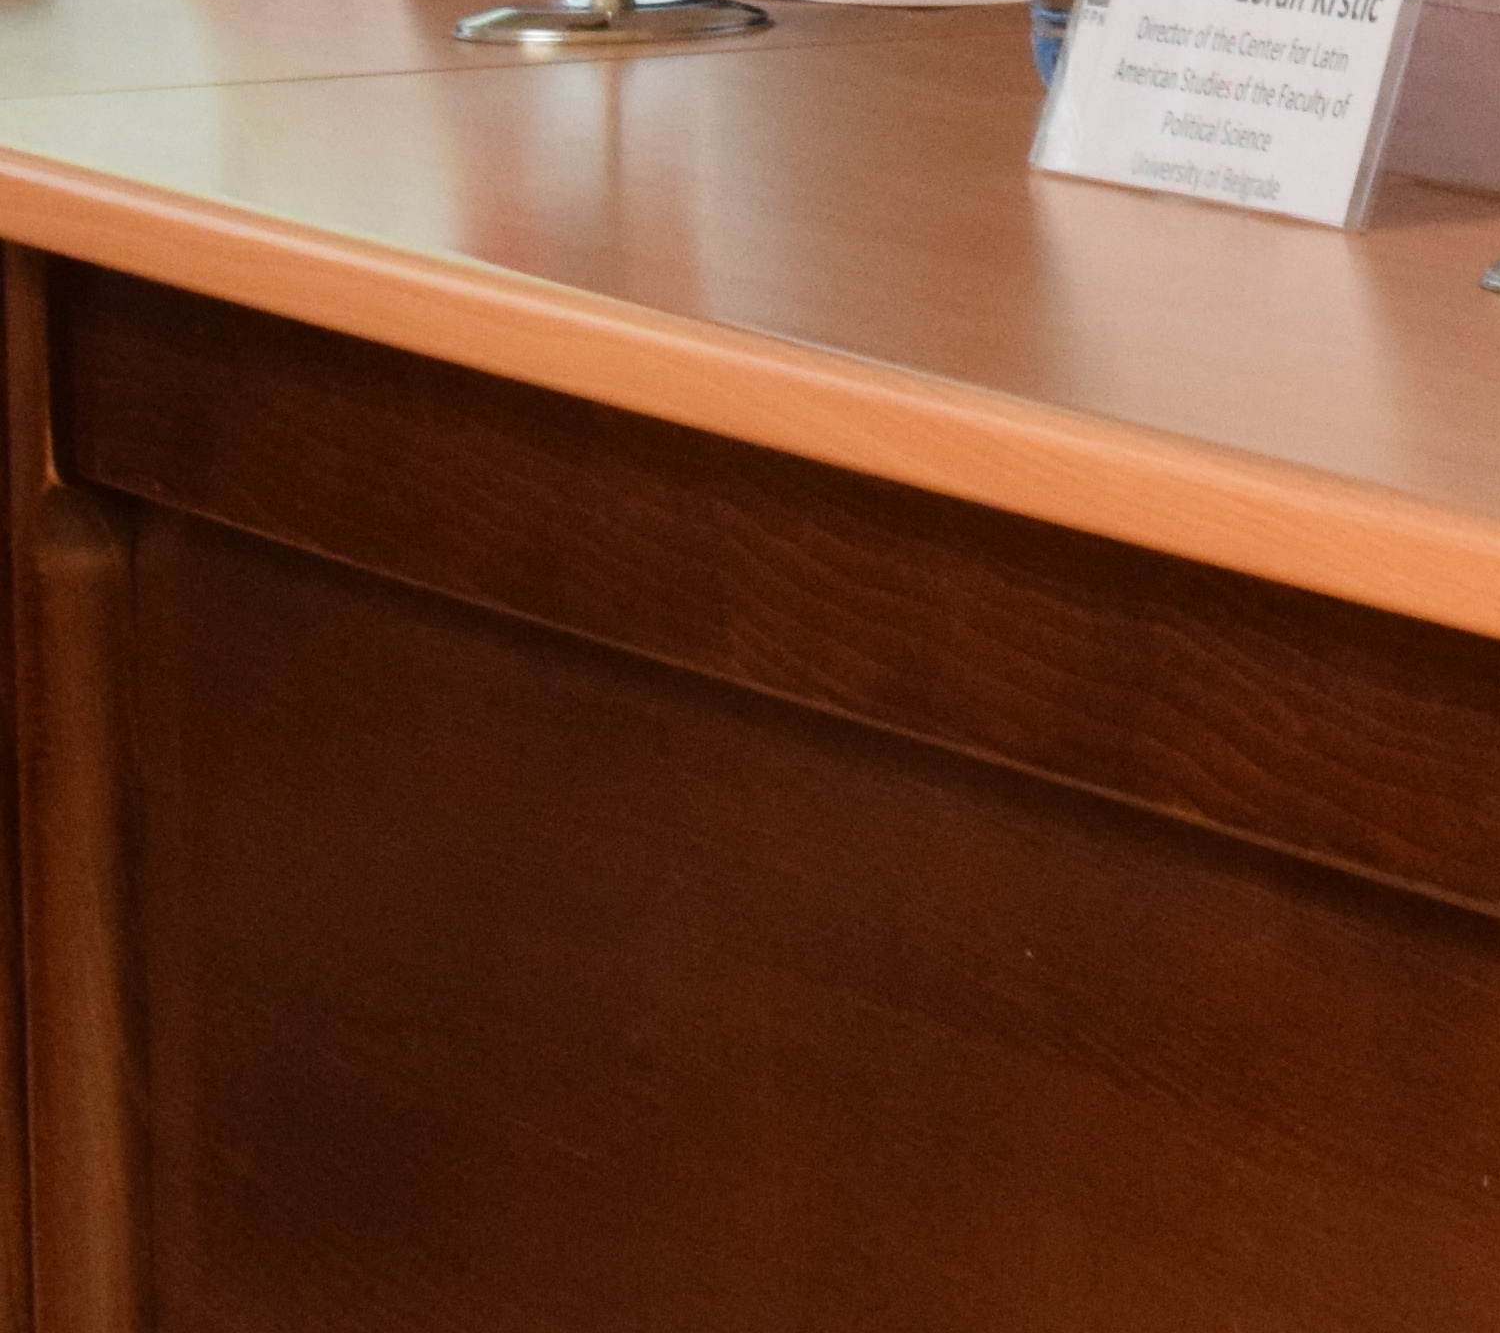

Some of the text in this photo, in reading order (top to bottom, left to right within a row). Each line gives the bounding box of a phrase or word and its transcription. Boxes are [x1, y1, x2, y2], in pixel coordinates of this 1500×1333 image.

[1239, 31, 1287, 61] Center
[1287, 38, 1311, 65] for
[1312, 43, 1349, 73] Latin
[1278, 83, 1330, 120] Faculty
[1332, 93, 1353, 118] of
